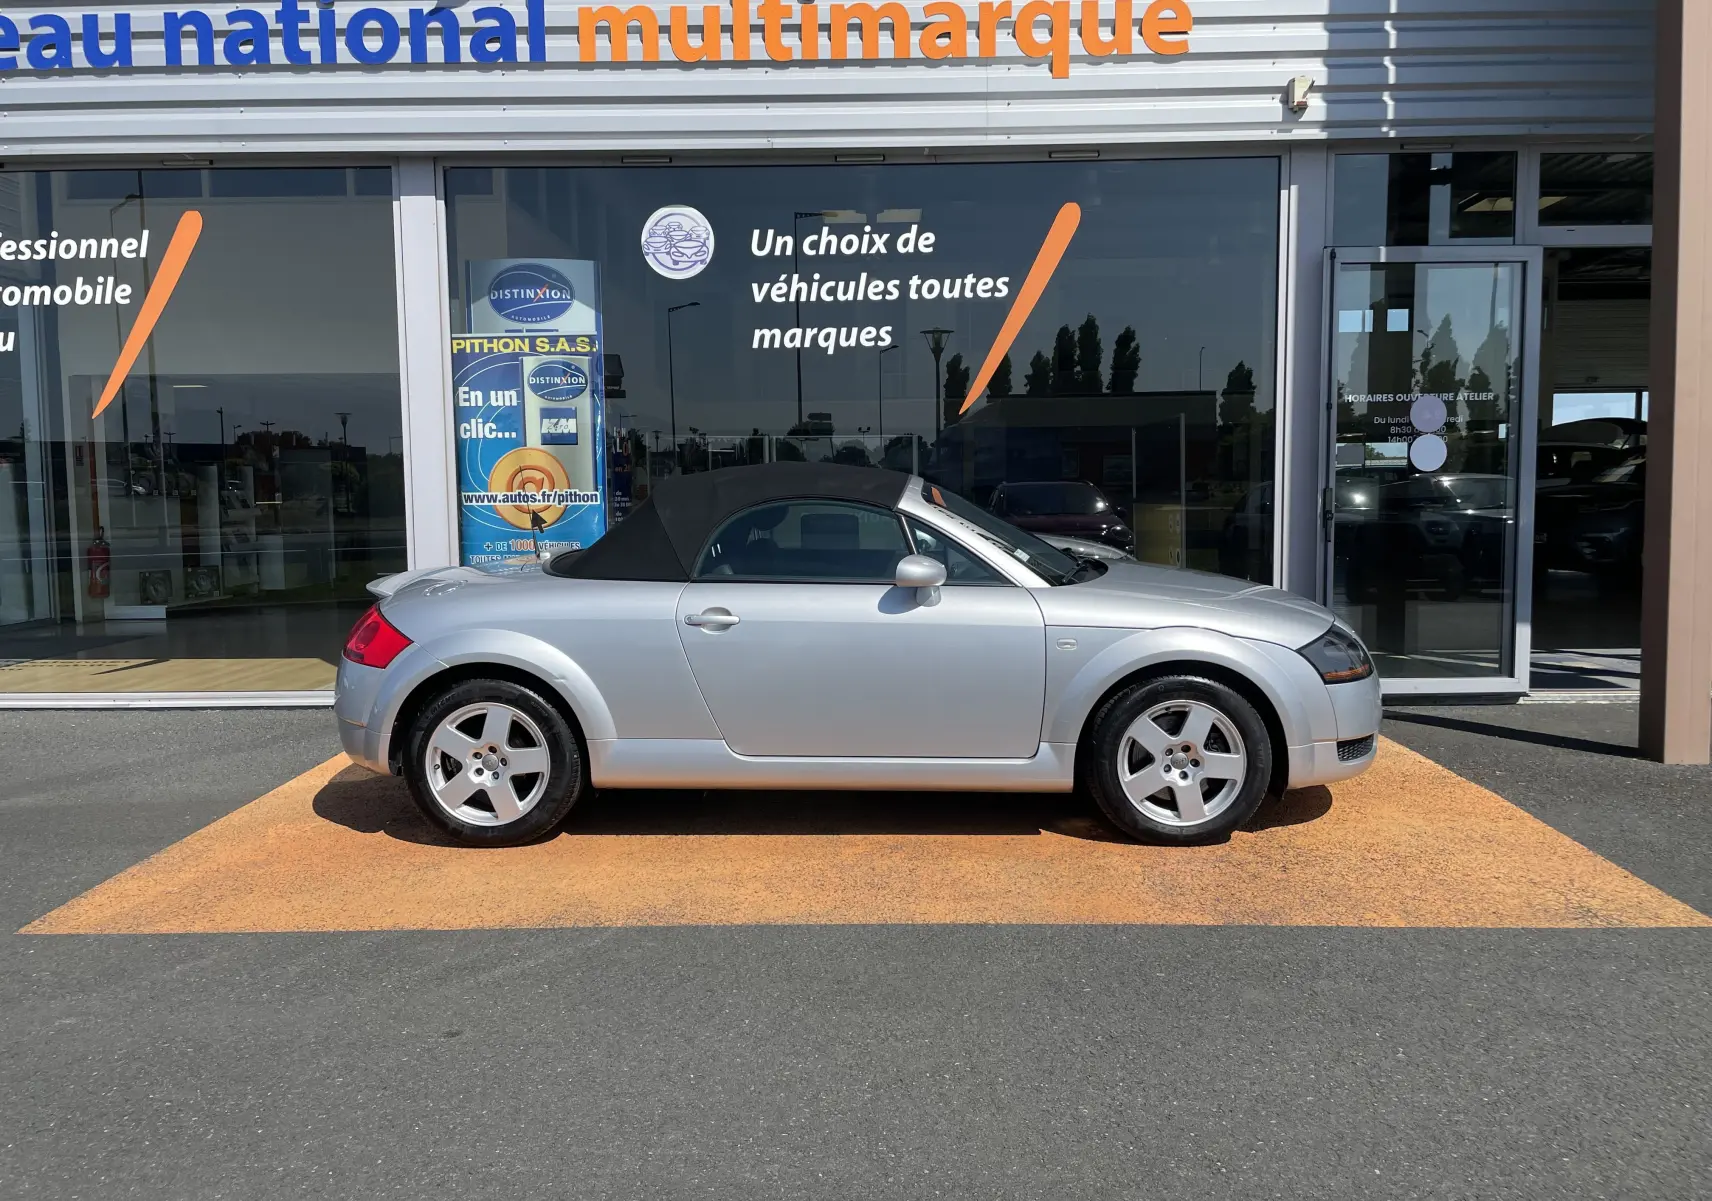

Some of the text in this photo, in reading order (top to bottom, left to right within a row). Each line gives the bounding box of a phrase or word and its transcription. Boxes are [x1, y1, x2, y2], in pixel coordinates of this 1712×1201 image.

[164, 0, 545, 67] national
[577, 0, 1193, 79] multimarque
[750, 224, 936, 257] Un choix de
[0, 275, 133, 307] omobile
[490, 286, 571, 300] DISTINXION
[751, 272, 1010, 304] véhicules toutes
[452, 336, 597, 353] PITHON S.A.S.
[752, 323, 893, 356] marques
[529, 374, 586, 384] DISTINXION
[458, 386, 518, 407] En un
[1344, 392, 1495, 403] HORAIRES OUVURE ATELIER
[1374, 416, 1386, 424] Du
[1387, 415, 1409, 424] lundi
[459, 418, 517, 439] clic...
[1390, 425, 1412, 434] 8h30
[1387, 435, 1413, 443] 14h00
[463, 490, 599, 506] www.autos.fr/pithon
[495, 541, 508, 551] DE
[508, 538, 536, 551] 1000
